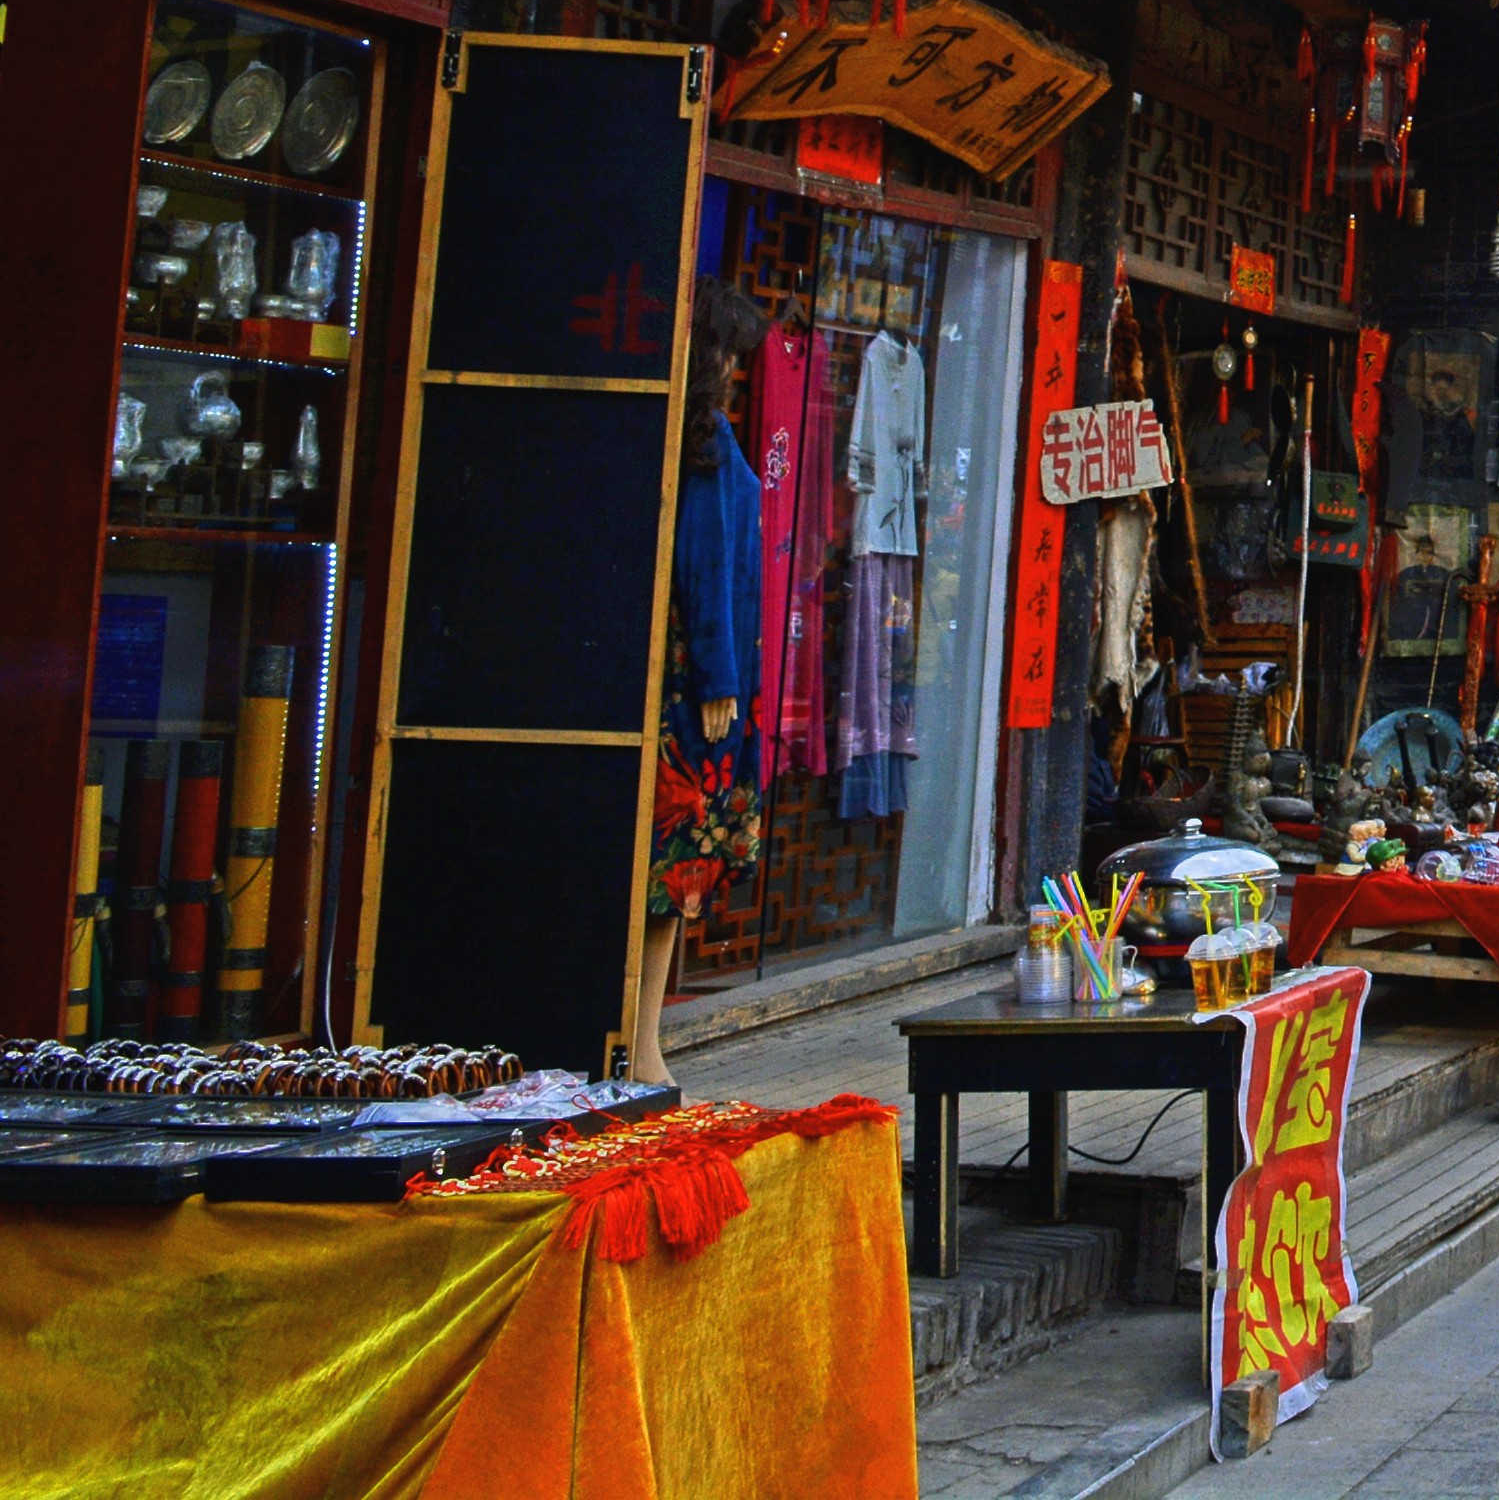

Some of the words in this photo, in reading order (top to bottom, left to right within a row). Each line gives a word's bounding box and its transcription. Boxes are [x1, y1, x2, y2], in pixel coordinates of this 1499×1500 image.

[771, 23, 1070, 135] 不可方物
[1042, 405, 1174, 499] 专治脚气
